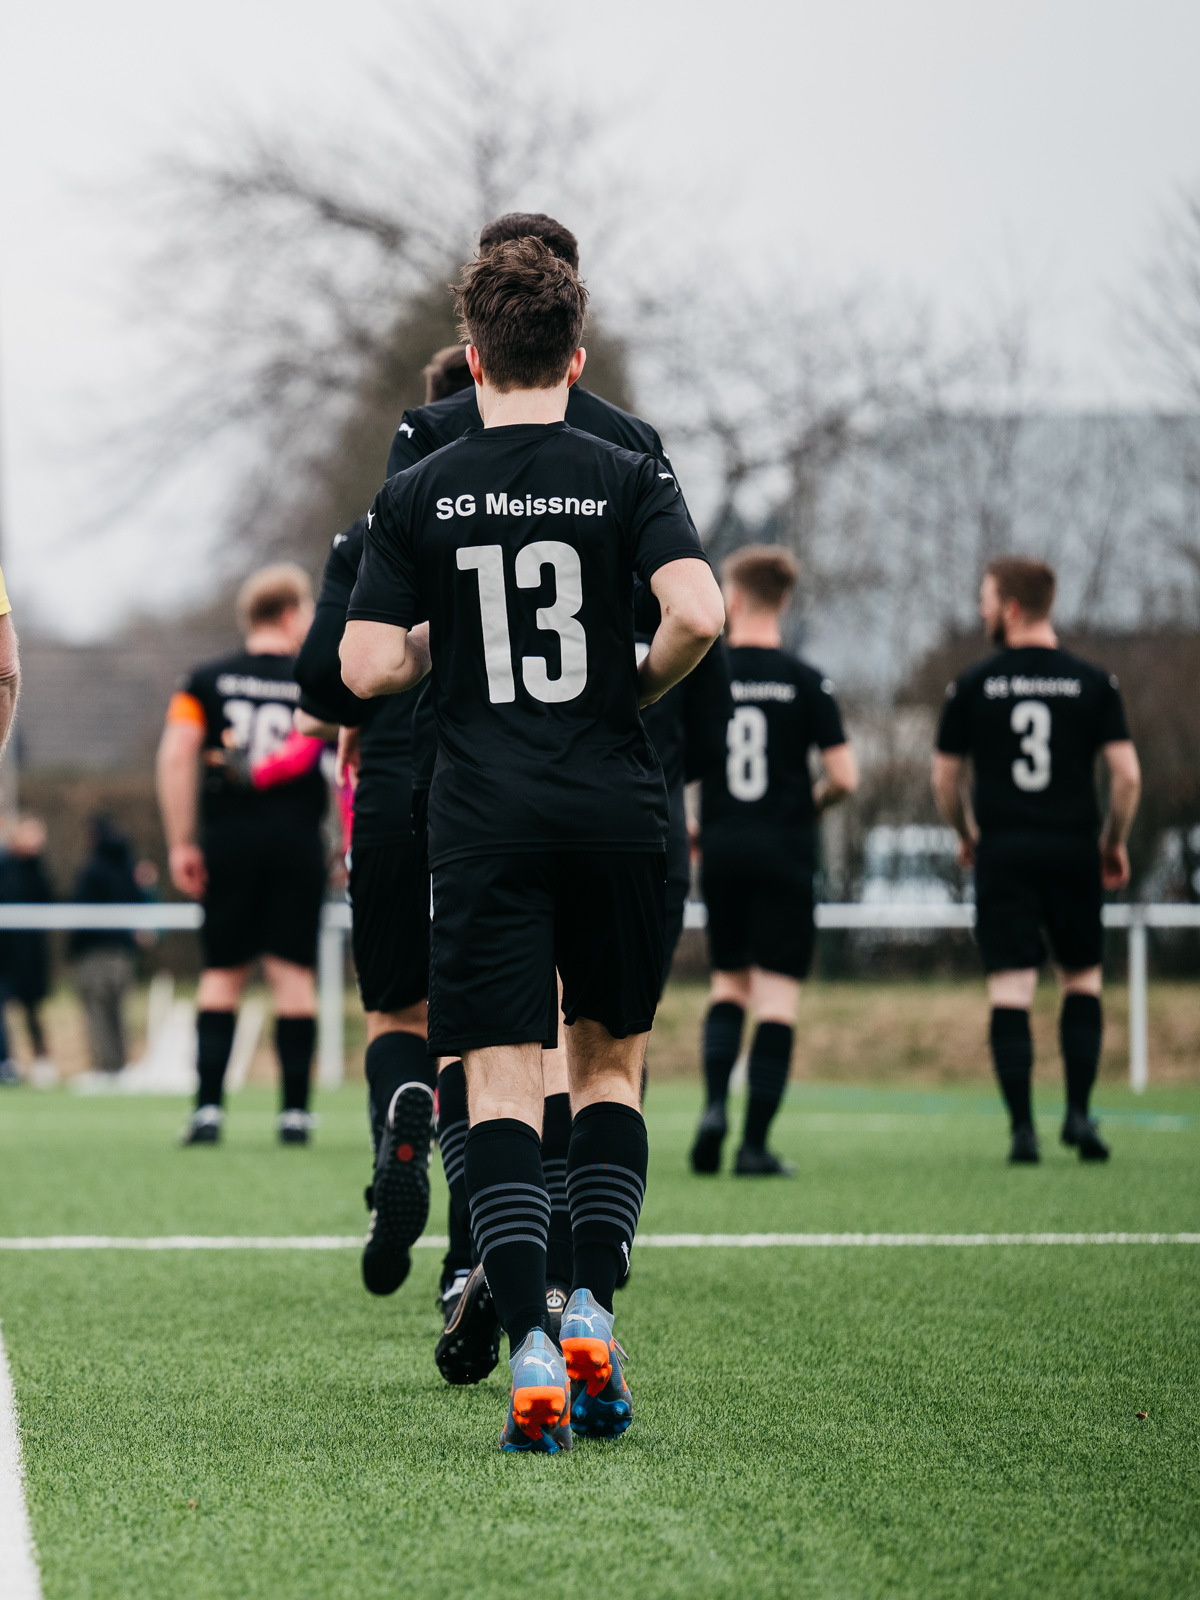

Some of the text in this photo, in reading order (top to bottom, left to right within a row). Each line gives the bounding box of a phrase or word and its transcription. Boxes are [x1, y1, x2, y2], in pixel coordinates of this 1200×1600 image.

[436, 492, 608, 520] SG Meissner
[455, 540, 588, 704] 13
[726, 706, 768, 801] 8
[1010, 701, 1051, 791] 3
